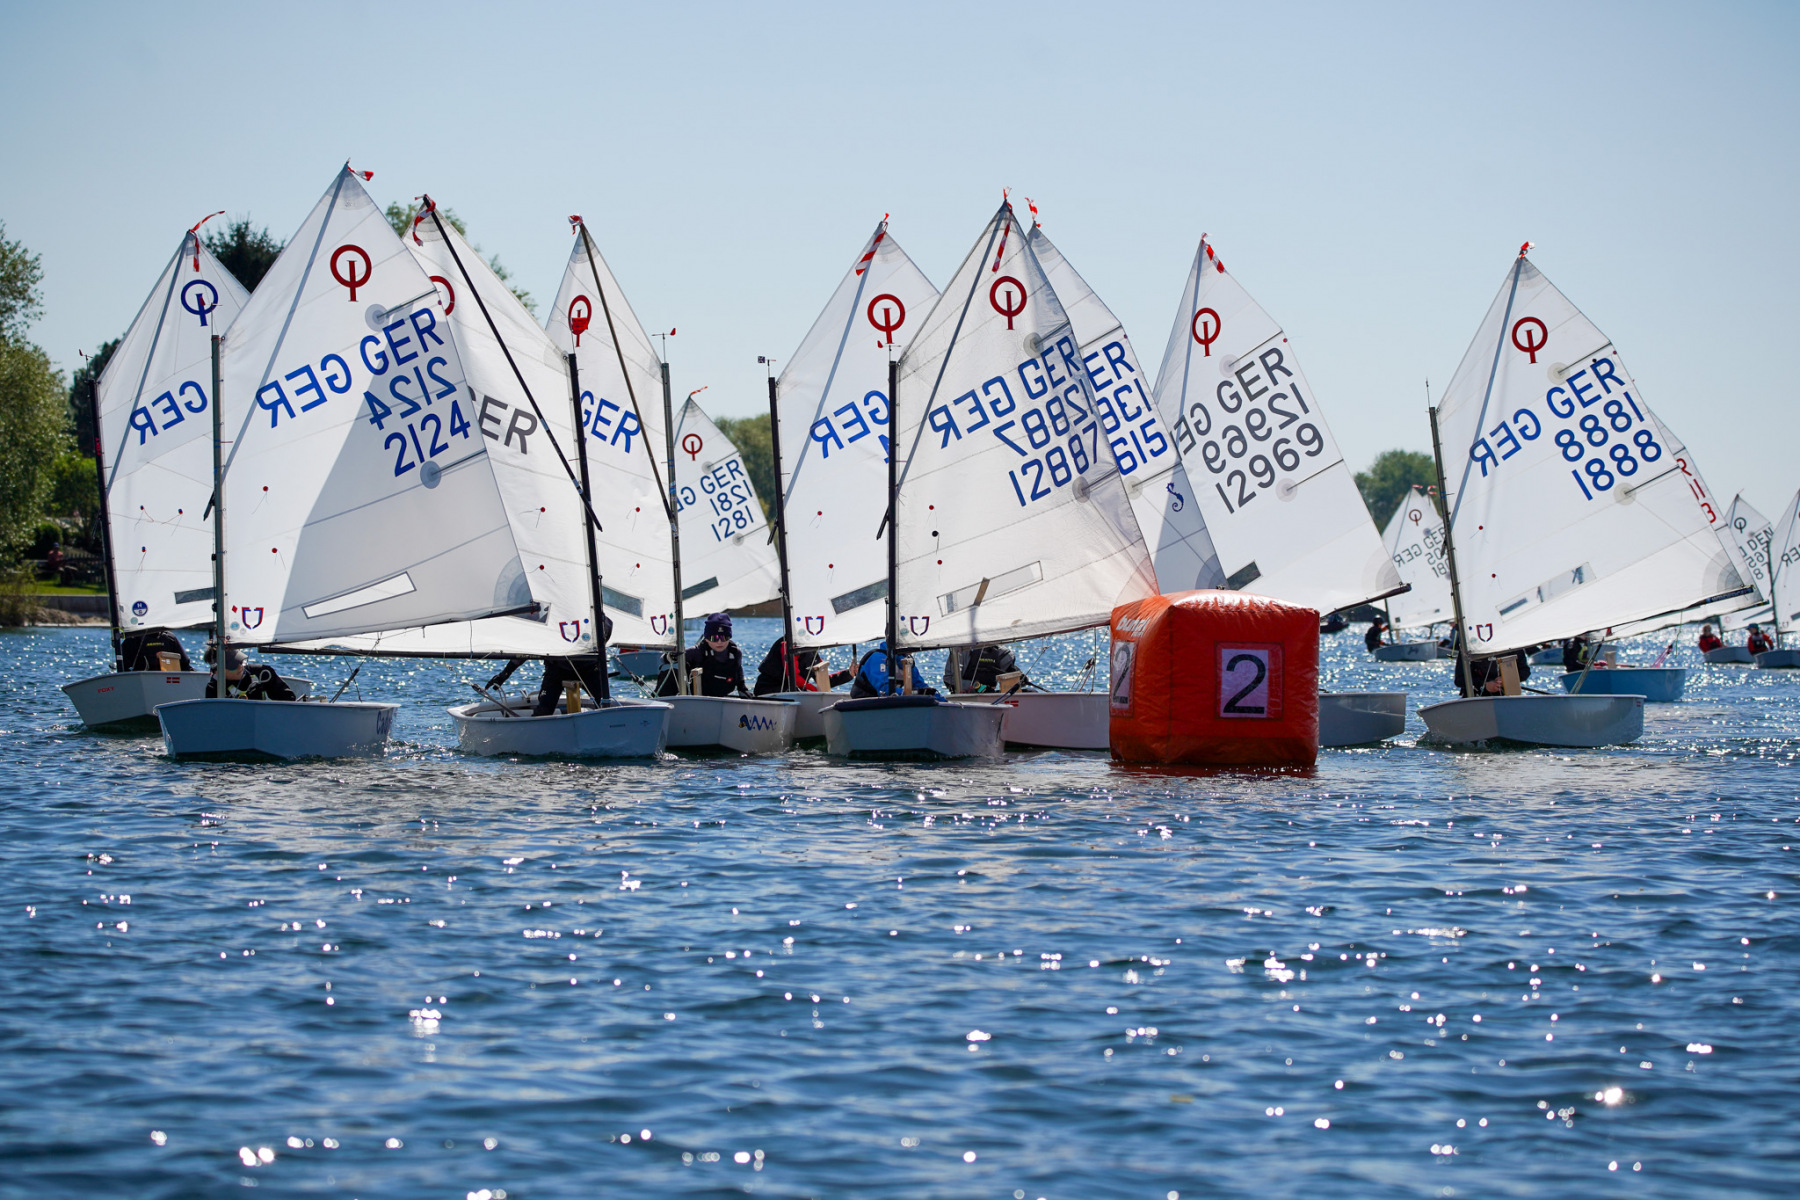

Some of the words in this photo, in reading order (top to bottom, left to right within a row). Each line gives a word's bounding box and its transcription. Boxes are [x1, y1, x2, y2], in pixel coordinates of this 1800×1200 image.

[359, 307, 444, 376] GER
[1017, 335, 1081, 400] GER
[1082, 341, 1135, 393] ER
[1216, 347, 1294, 414] GER
[1546, 357, 1625, 419] GER
[384, 400, 471, 477] 2124
[467, 385, 538, 455] ER
[580, 390, 641, 454] GER
[1110, 417, 1168, 476] 615
[700, 459, 744, 494] GER
[1008, 420, 1098, 508] 12887
[1215, 422, 1324, 515] 12969
[1571, 429, 1662, 501] 1888
[711, 505, 754, 542] 1281
[1747, 526, 1774, 552] DEN
[1113, 644, 1131, 704] 2
[1223, 653, 1266, 715] 2
